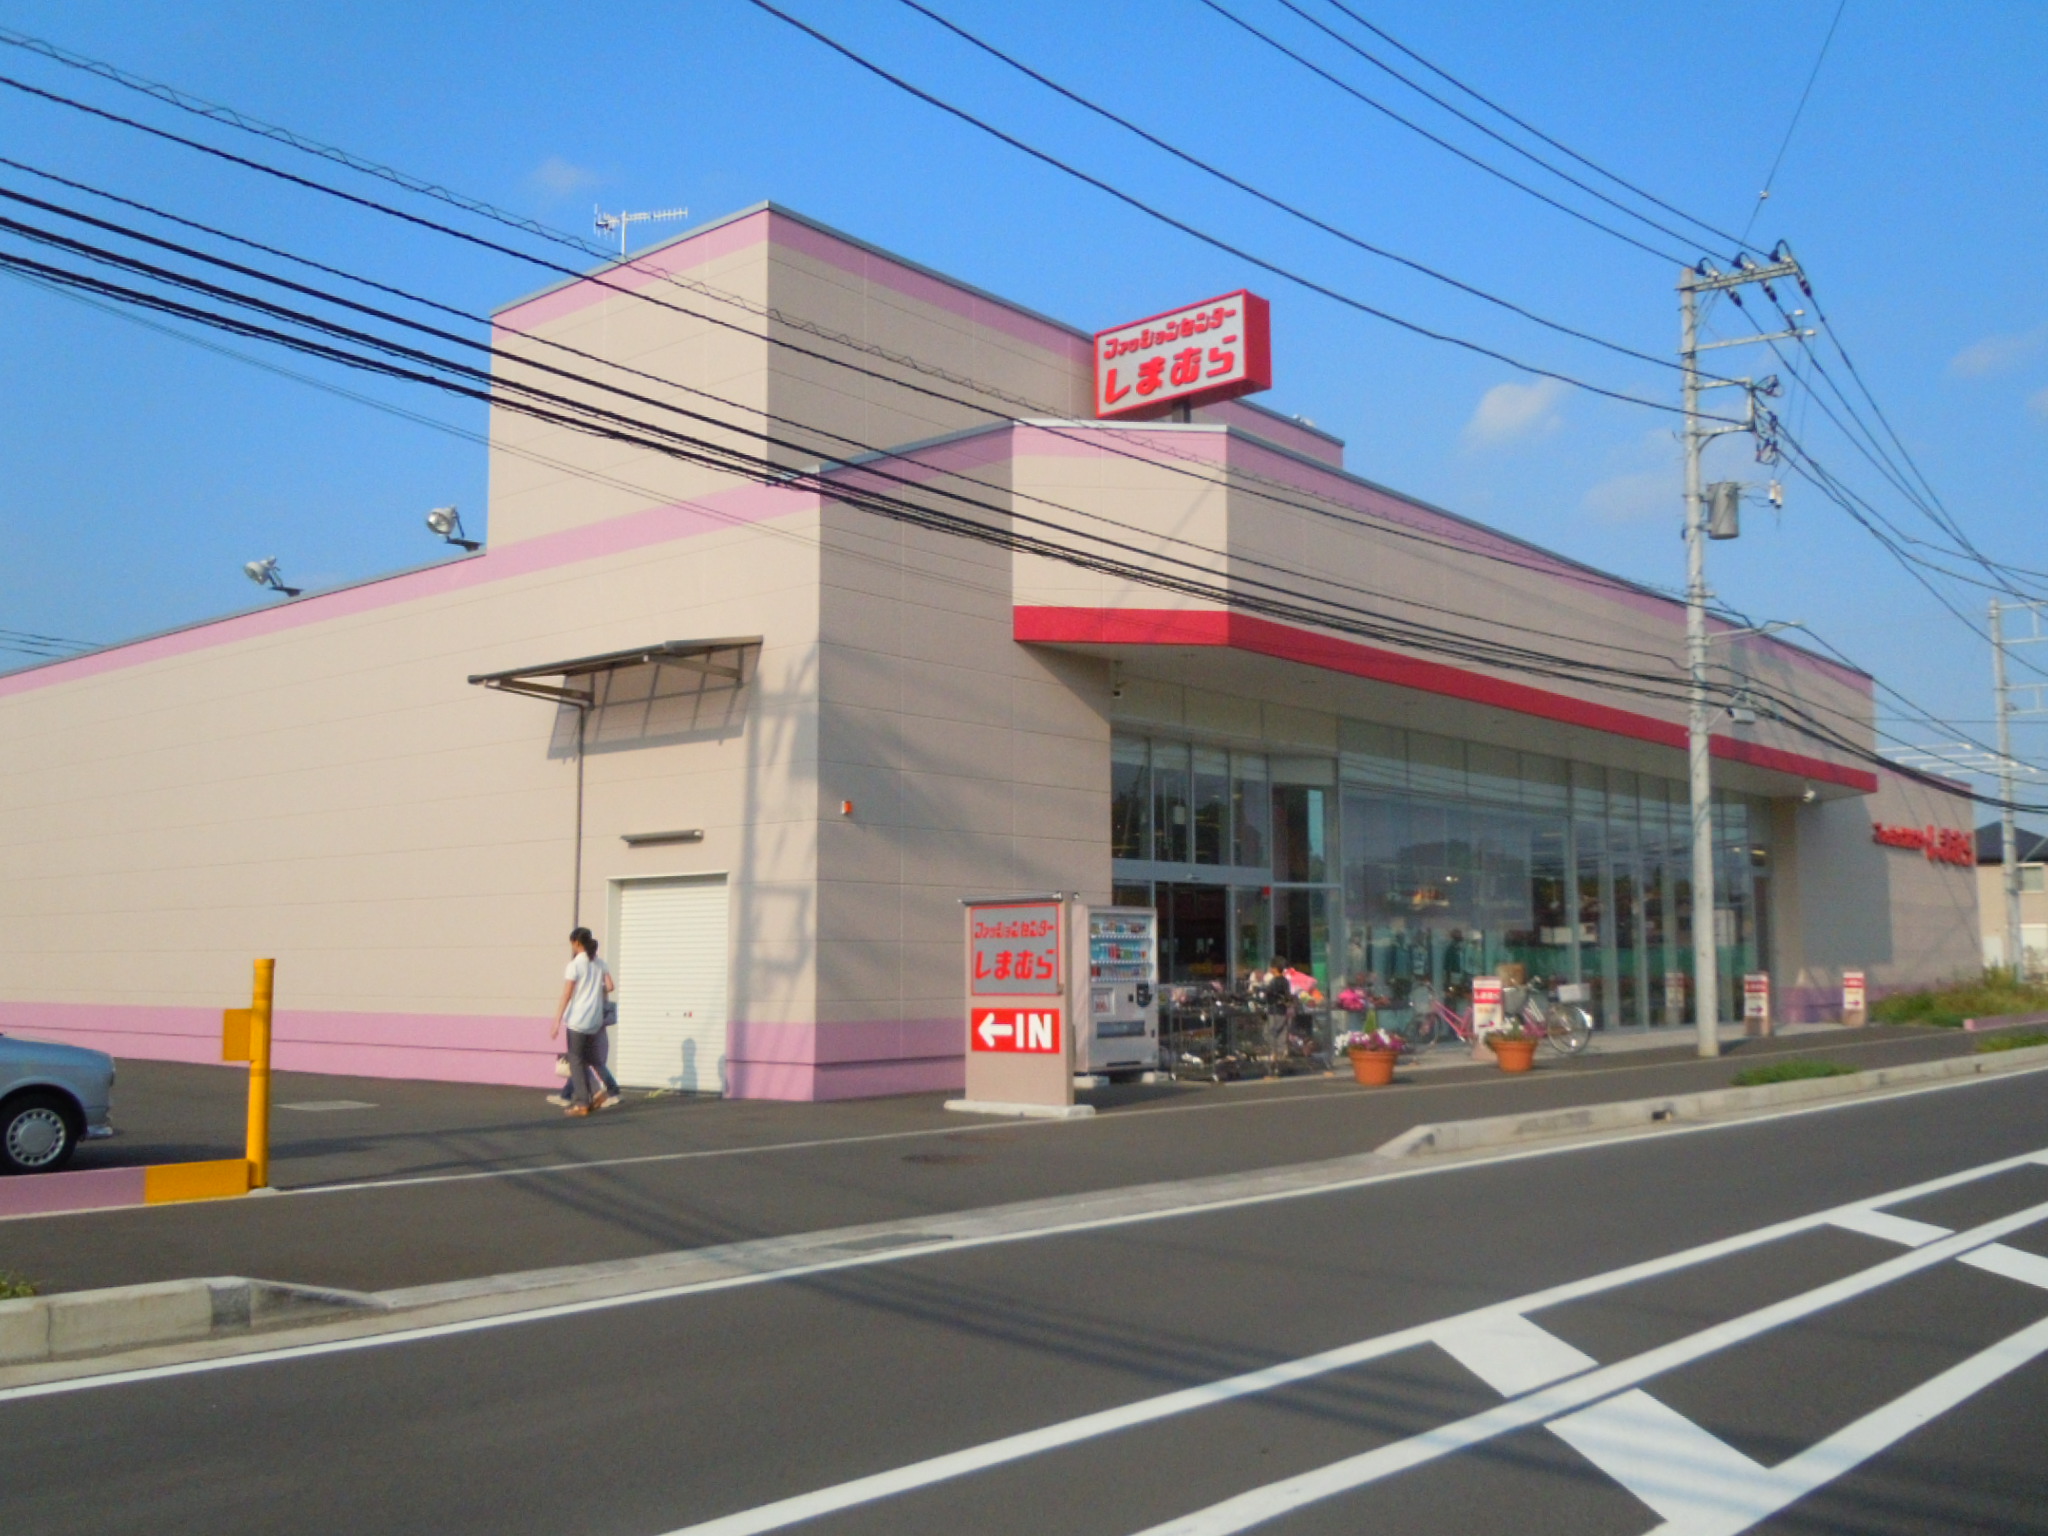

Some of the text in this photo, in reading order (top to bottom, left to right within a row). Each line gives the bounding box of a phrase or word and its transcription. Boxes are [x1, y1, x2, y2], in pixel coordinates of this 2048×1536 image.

[1104, 307, 1236, 359] ファッションセンター
[1105, 335, 1237, 404] しまむら
[975, 949, 1055, 979] しまむら
[1015, 1013, 1052, 1048] IN
